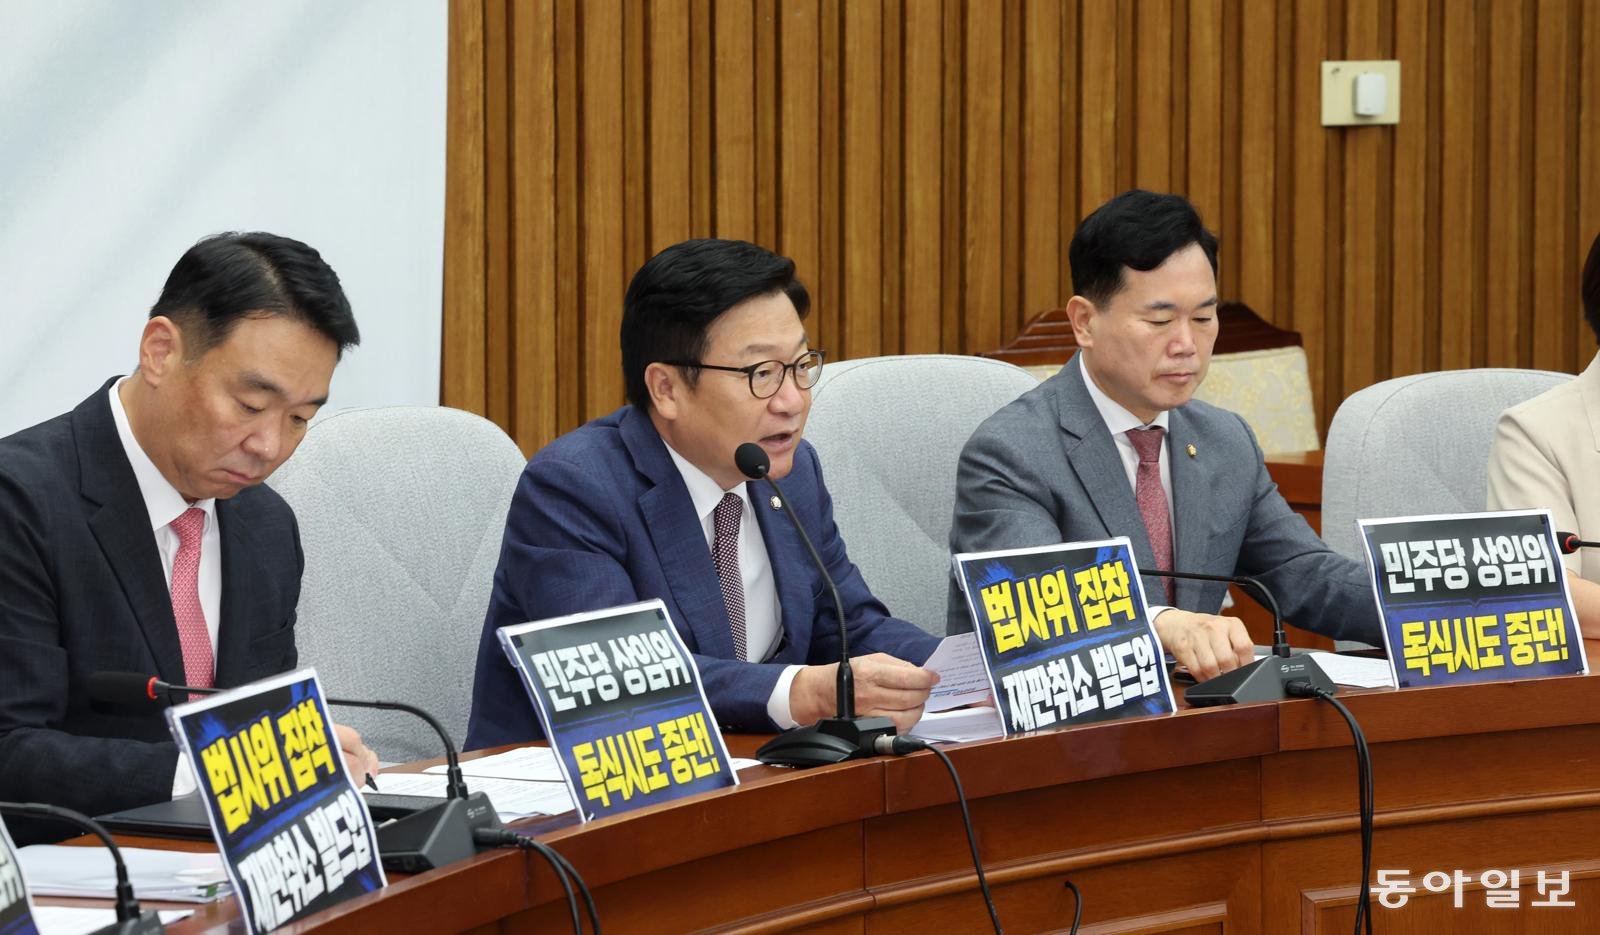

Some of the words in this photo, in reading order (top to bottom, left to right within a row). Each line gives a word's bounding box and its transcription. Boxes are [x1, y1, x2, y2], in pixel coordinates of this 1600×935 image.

[981, 569, 1078, 654] 법사위
[1074, 560, 1136, 631] 집착
[1380, 538, 1469, 593] 민주당
[1471, 533, 1556, 587] 상임위
[531, 642, 620, 712] 민주당
[607, 629, 692, 696] 상임위
[1002, 654, 1100, 732] 재판취소
[1089, 634, 1160, 710] 빌드업
[1401, 615, 1504, 676] 독식시도
[1504, 608, 1568, 666] 중단!
[201, 716, 292, 834] 법사위
[279, 698, 336, 793] 집착
[572, 726, 670, 807] 독식시도
[657, 712, 721, 785] 중단!
[237, 830, 324, 934] 재판취소
[305, 790, 372, 893] 빌드업
